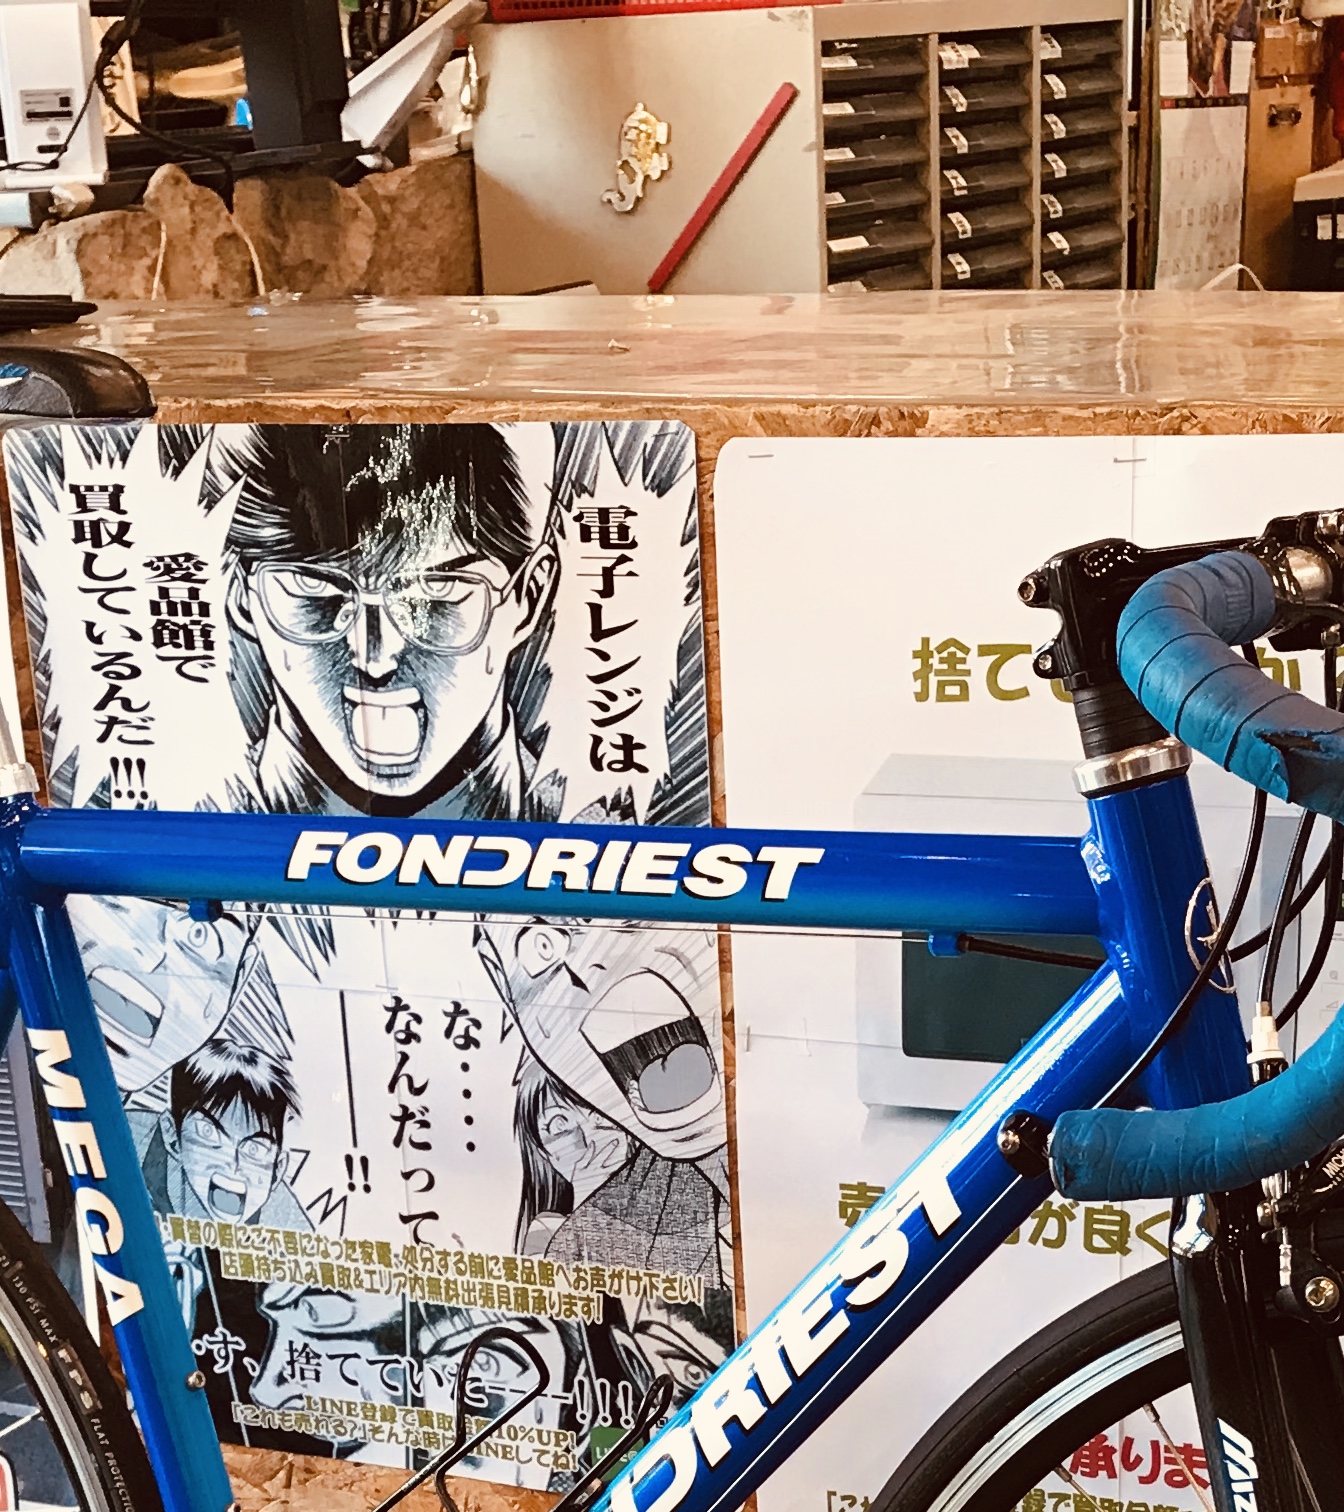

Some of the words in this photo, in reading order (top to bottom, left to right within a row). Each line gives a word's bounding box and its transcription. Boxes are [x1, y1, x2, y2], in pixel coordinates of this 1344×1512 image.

[142, 551, 218, 684] 愛品館で
[572, 504, 650, 776] 電子レンジは
[286, 830, 826, 907] FONDRIEST
[383, 995, 443, 1246] なんだって
[27, 1028, 146, 1321] MEGA
[39, 1317, 59, 1345] MAX
[58, 1348, 94, 1408] FPS
[90, 1417, 110, 1446] FLAT
